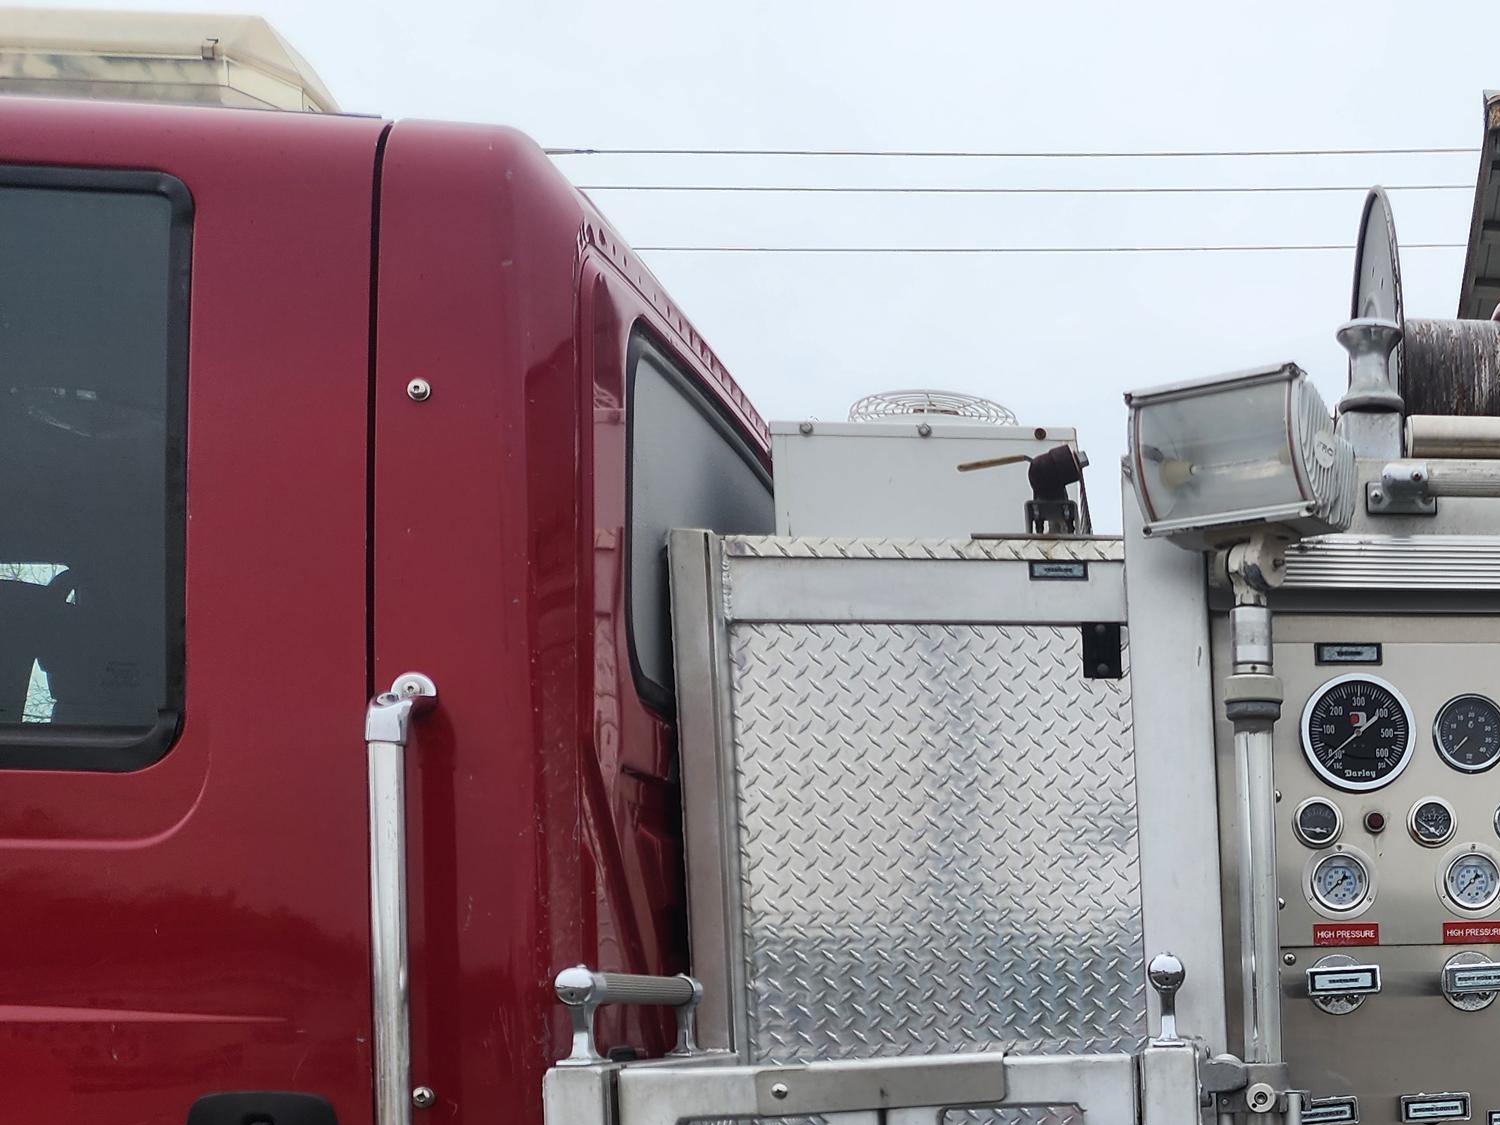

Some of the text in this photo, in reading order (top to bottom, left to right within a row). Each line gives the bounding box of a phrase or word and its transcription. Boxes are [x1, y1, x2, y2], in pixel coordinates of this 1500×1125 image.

[1352, 697, 1365, 706] 300
[1330, 707, 1342, 716] 200
[1376, 709, 1388, 717] 400
[1323, 725, 1334, 734] 100
[1381, 728, 1393, 737] 500
[1376, 749, 1388, 758] 600
[1317, 930, 1375, 938] HIGH PRESSURE
[1447, 929, 1464, 937] HIGH
